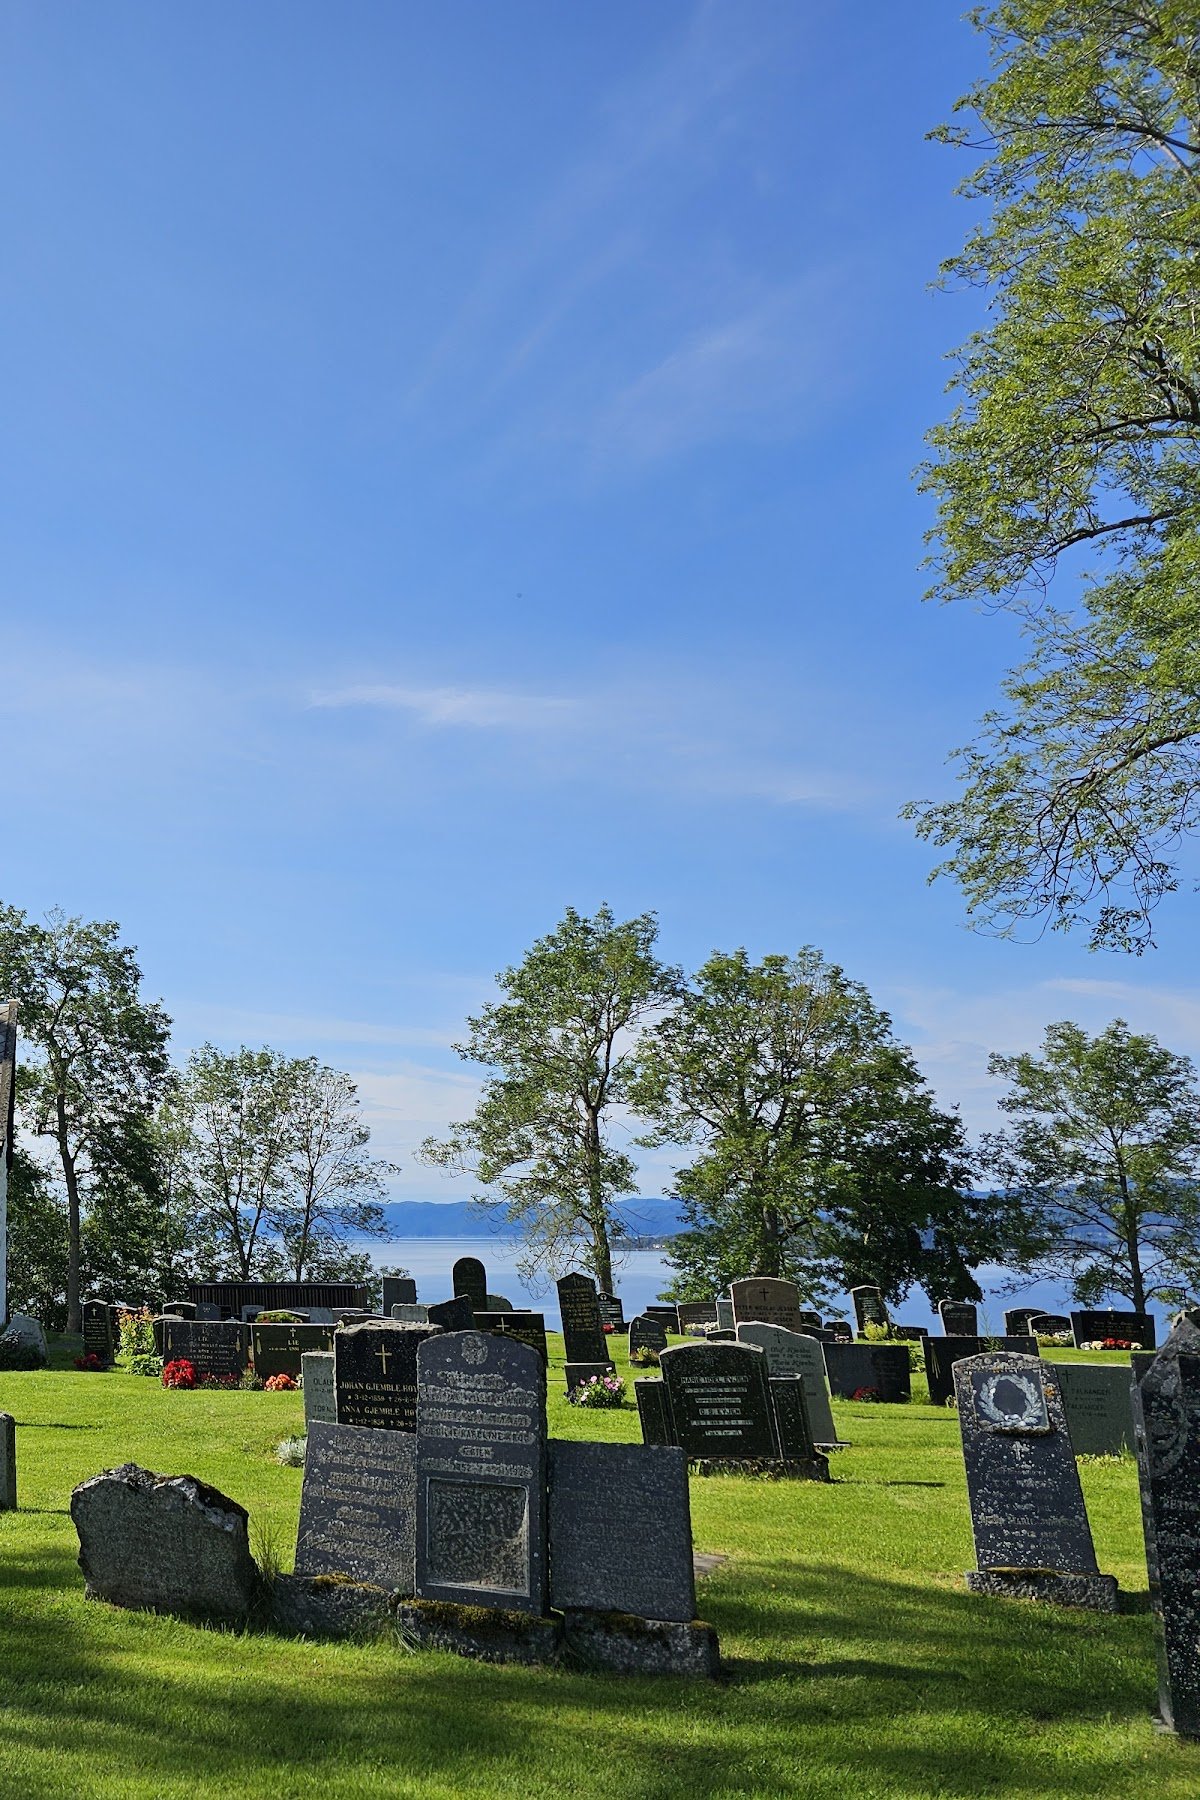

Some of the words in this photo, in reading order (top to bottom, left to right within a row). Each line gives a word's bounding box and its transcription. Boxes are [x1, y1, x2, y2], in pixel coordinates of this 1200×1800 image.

[339, 1381, 365, 1390] JOHAN
[365, 1383, 401, 1393] GJEMBLE
[341, 1405, 361, 1414] ANNA
[364, 1406, 401, 1416] GJEMBLE
